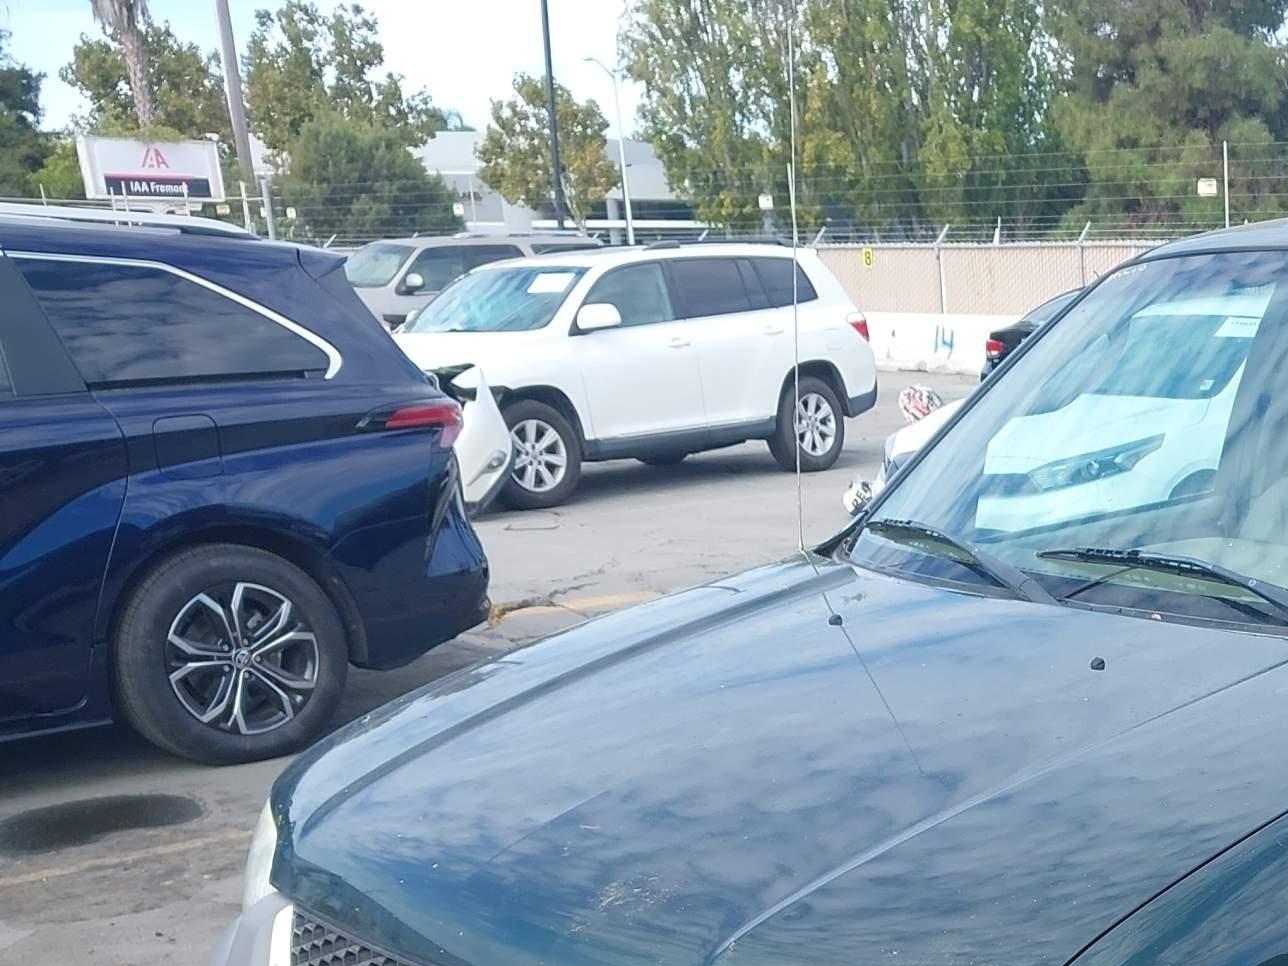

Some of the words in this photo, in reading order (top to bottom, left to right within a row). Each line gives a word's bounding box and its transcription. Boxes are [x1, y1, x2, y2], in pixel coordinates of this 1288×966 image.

[130, 181, 149, 193] IAA
[864, 250, 872, 266] 8
[934, 324, 954, 360] 14
